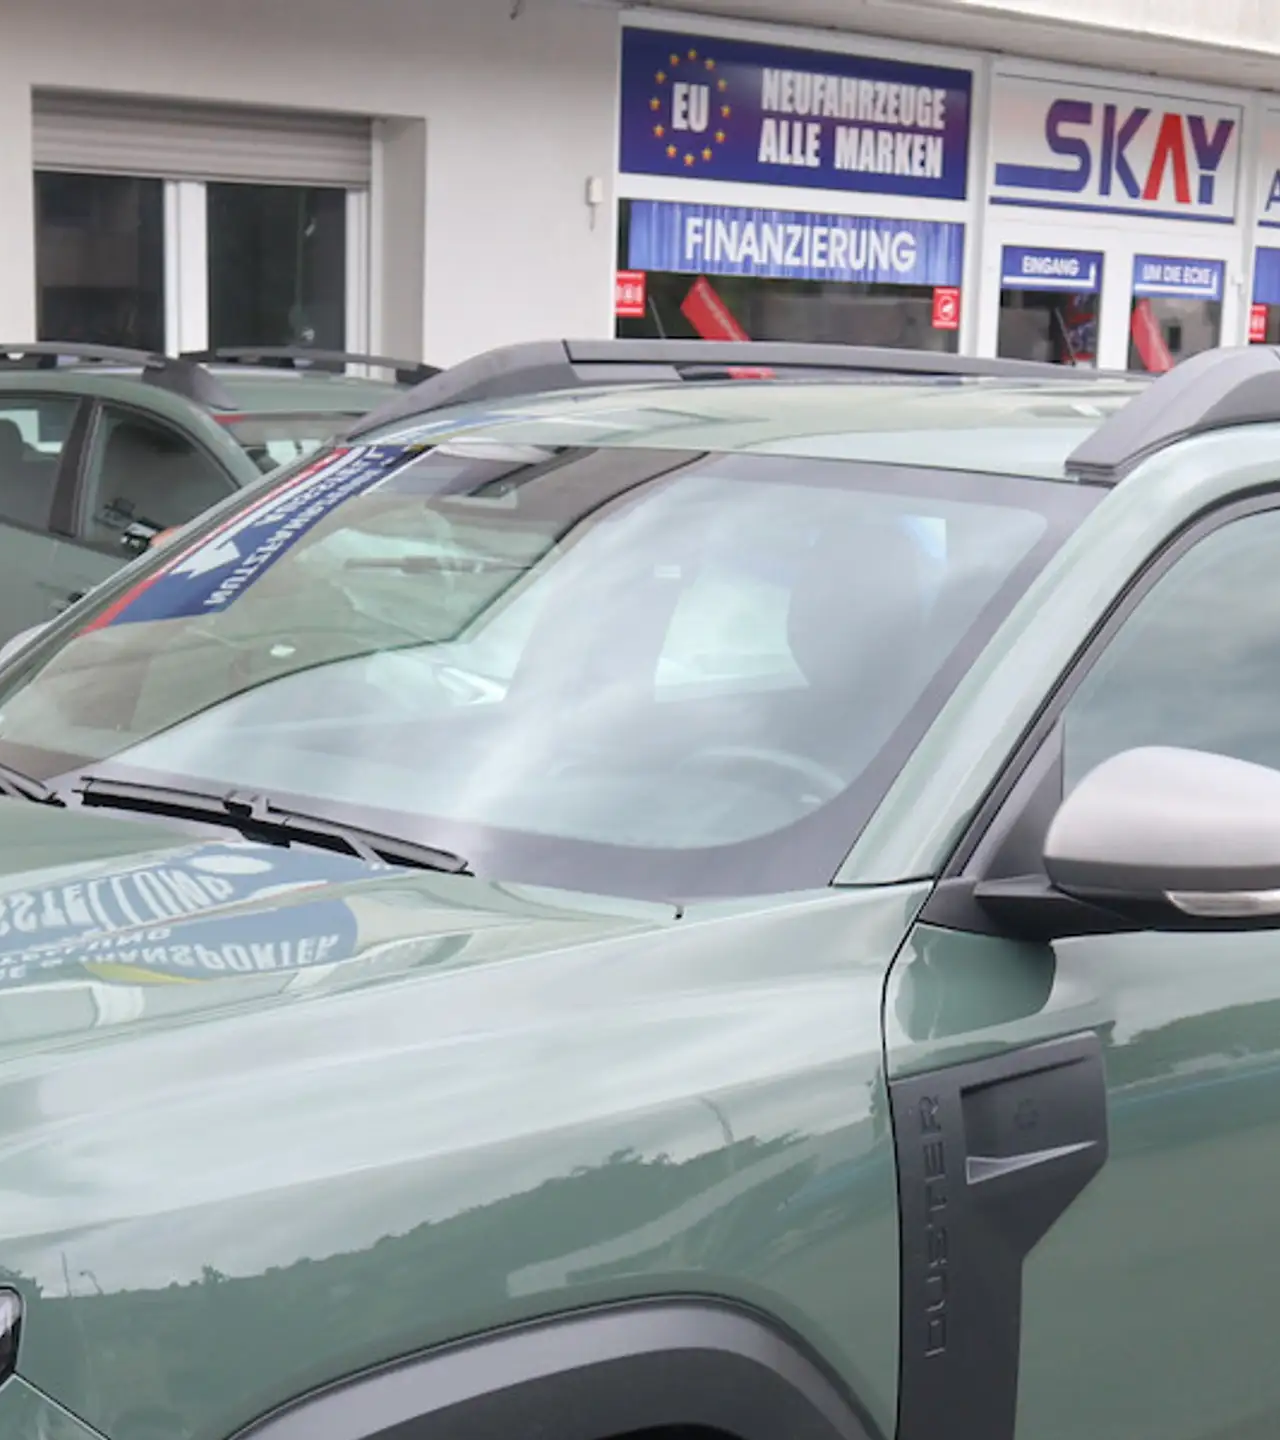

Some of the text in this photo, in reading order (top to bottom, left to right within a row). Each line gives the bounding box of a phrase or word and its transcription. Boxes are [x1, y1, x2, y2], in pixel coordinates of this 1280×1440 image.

[672, 82, 709, 133] EU
[761, 68, 947, 130] NEUFAHRZEUGE
[758, 119, 944, 179] ALLE MARKEN
[995, 99, 1235, 205] SKAY
[685, 217, 918, 272] FINANZIERUNG
[1022, 255, 1080, 277] EINGANG
[919, 1094, 949, 1359] DUSTER
